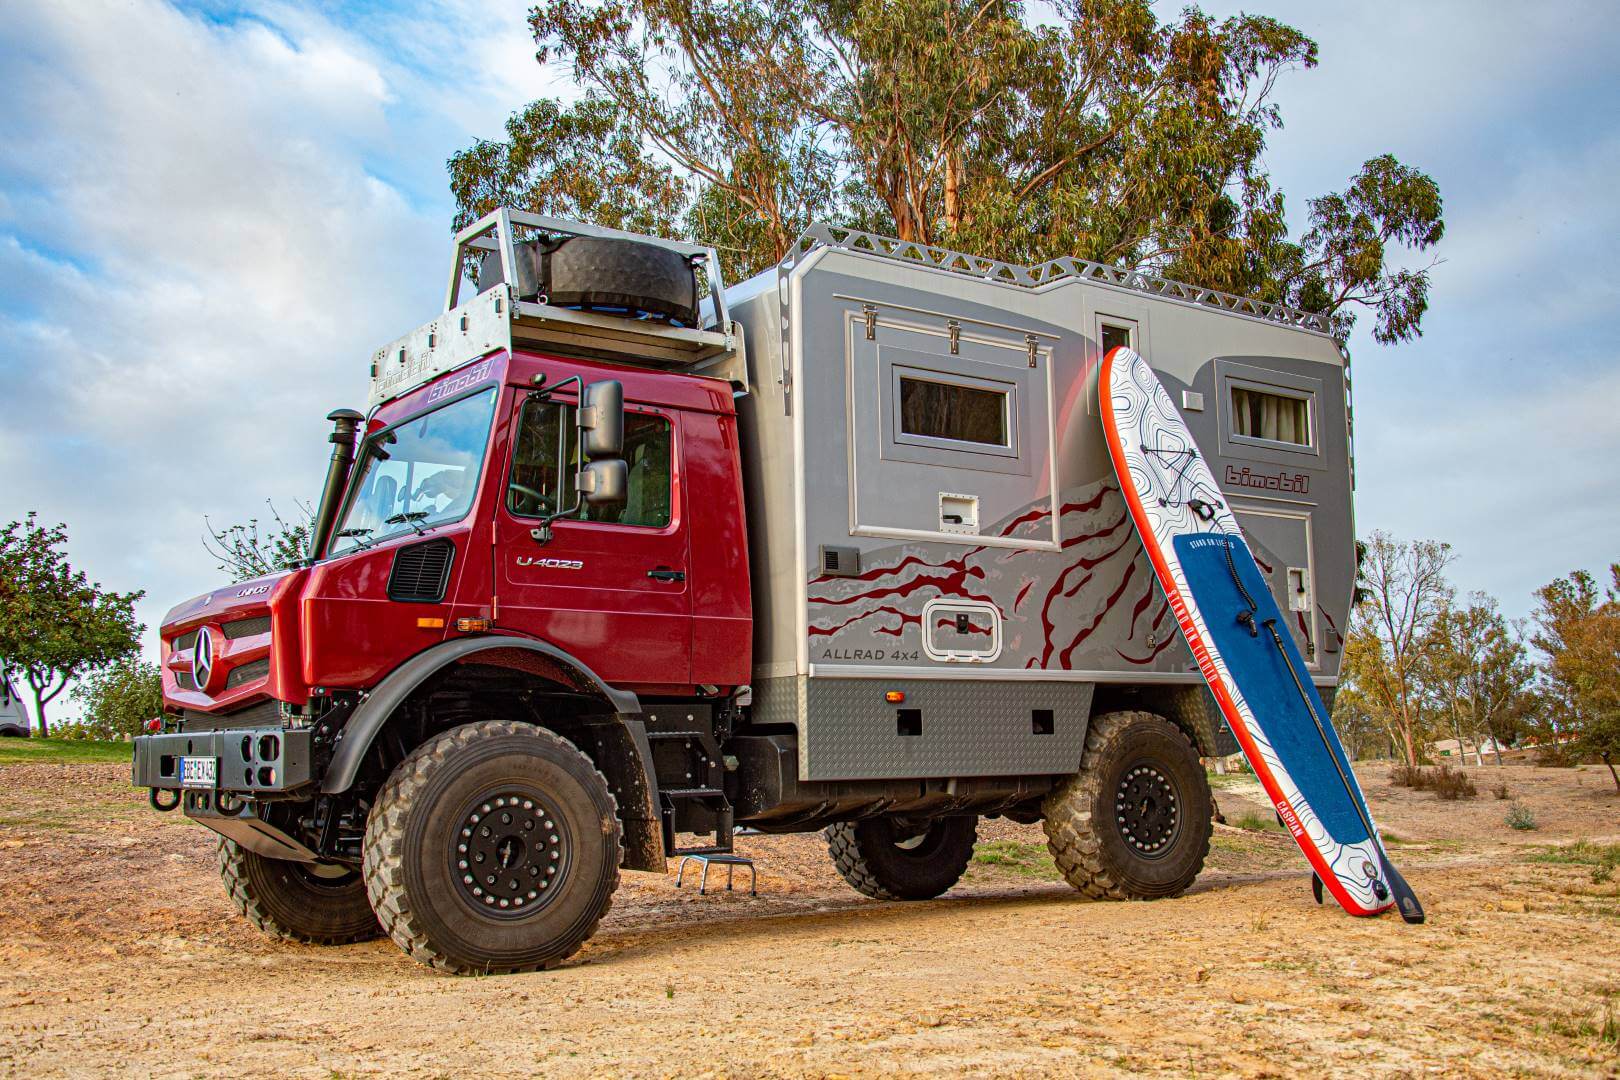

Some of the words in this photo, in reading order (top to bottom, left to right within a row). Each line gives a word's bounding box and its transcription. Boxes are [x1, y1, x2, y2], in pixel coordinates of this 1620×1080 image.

[427, 359, 495, 404] bimobil
[1224, 465, 1310, 494] bimobil
[1206, 538, 1216, 546] ON
[516, 556, 533, 566] U
[533, 558, 584, 570] 4023
[1167, 589, 1189, 624] STAND
[1184, 626, 1199, 643] ON
[1193, 644, 1218, 683] LIQUID
[822, 648, 885, 660] ALLRAD
[890, 650, 920, 660] 4x4
[1276, 800, 1305, 838] CASPIAN
